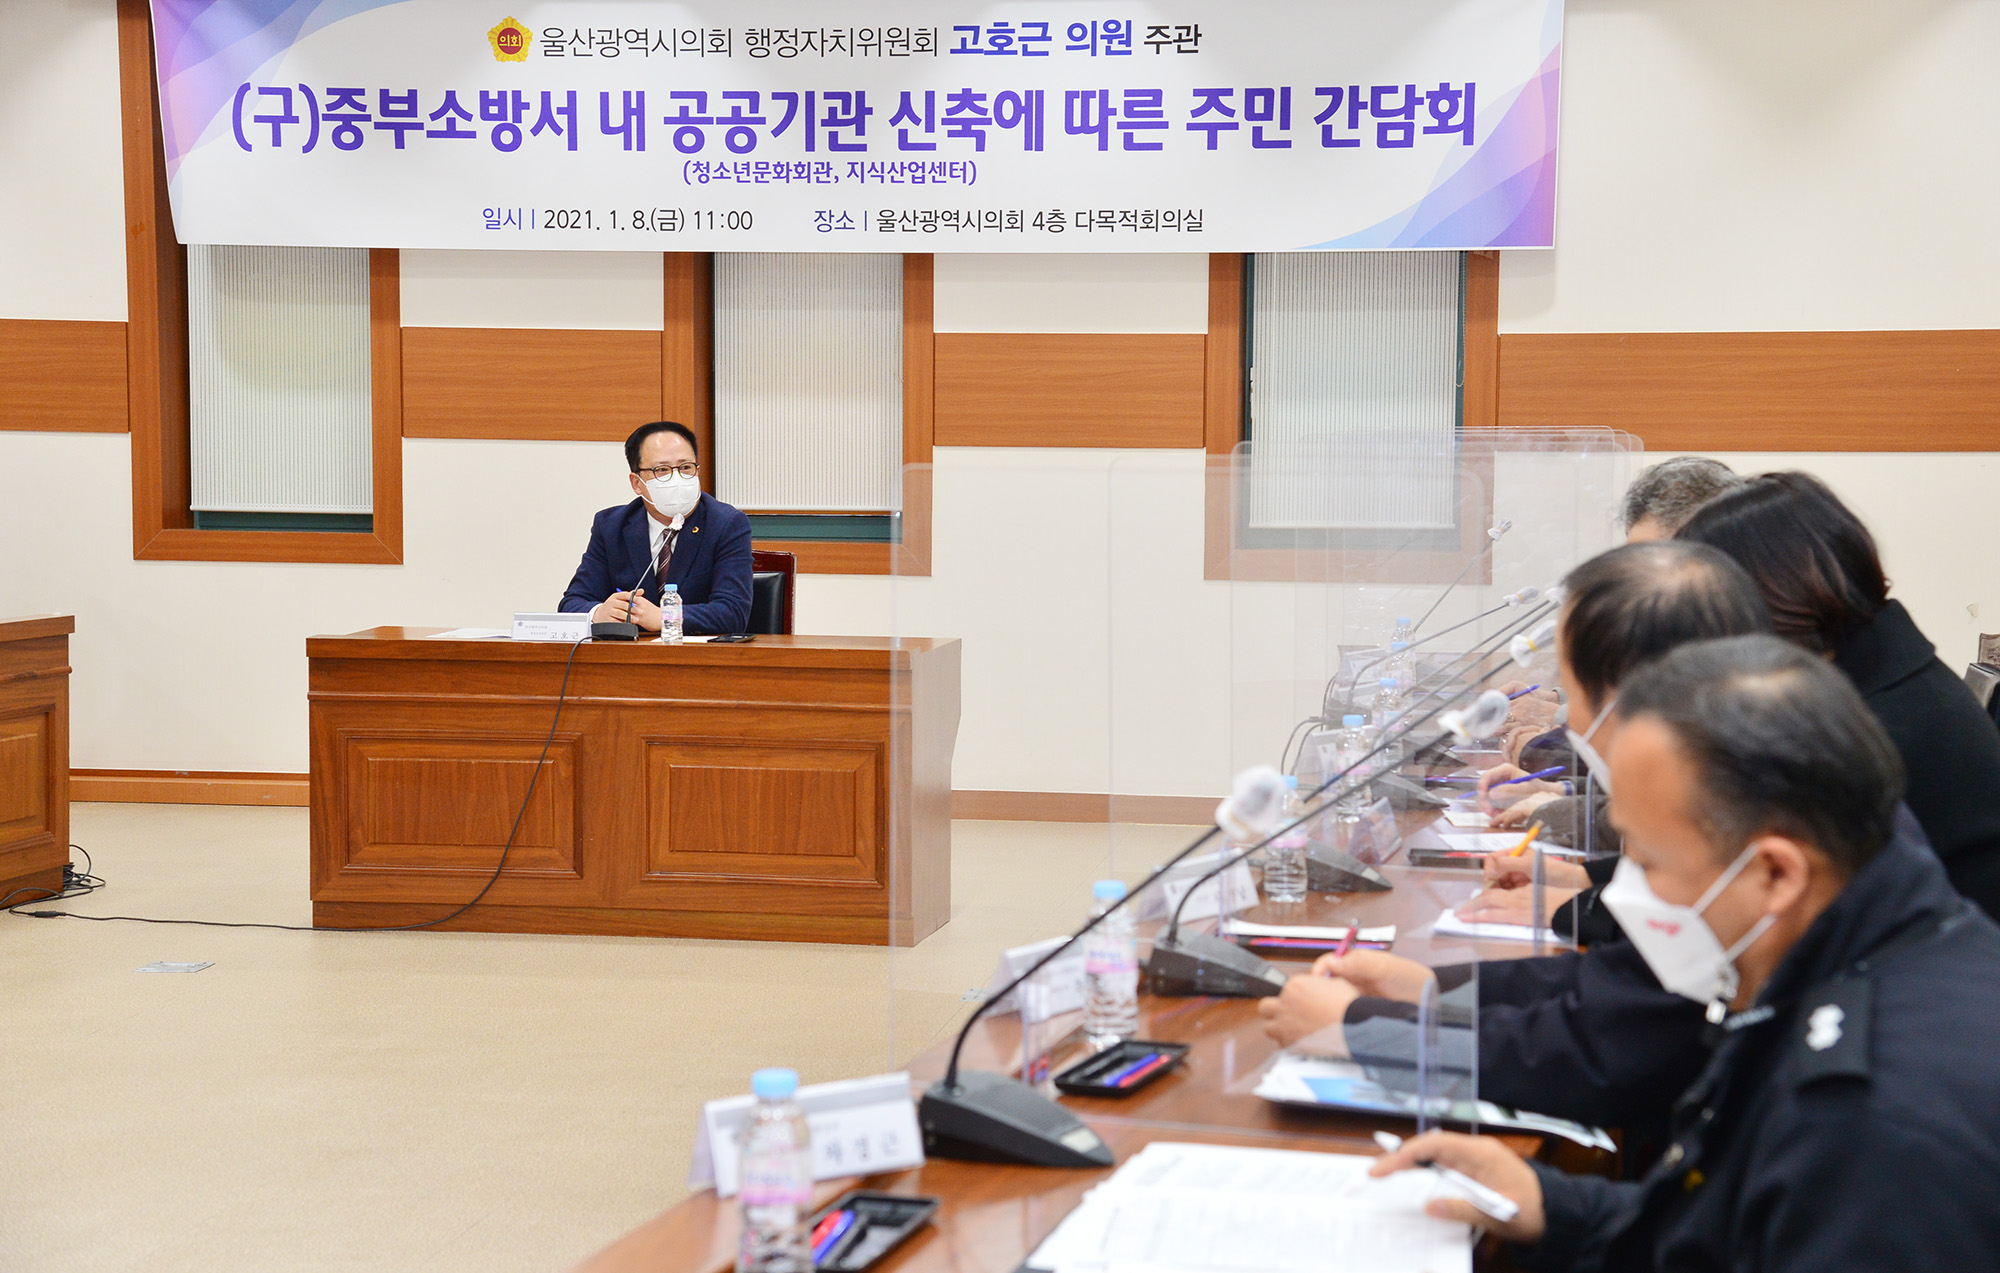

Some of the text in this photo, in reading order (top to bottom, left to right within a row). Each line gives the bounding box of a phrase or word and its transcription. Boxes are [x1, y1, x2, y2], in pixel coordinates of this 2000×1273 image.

[499, 35, 522, 47] 의회
[539, 19, 1203, 59] 울산광역시의회 행정자치위원회 고호근 의원 주관
[231, 81, 1477, 155] (구)중부소방서 내 공공기관 신축에 따른 주민 간담회
[683, 159, 977, 187] (청소년문화회관, 지식산업센터)
[482, 207, 522, 231] 일시
[543, 209, 601, 231] 2021.
[609, 209, 626, 231] 1.
[693, 209, 753, 231] 11:00
[813, 208, 1203, 234] 장소 울산광역시의회 4층 다목적회의실
